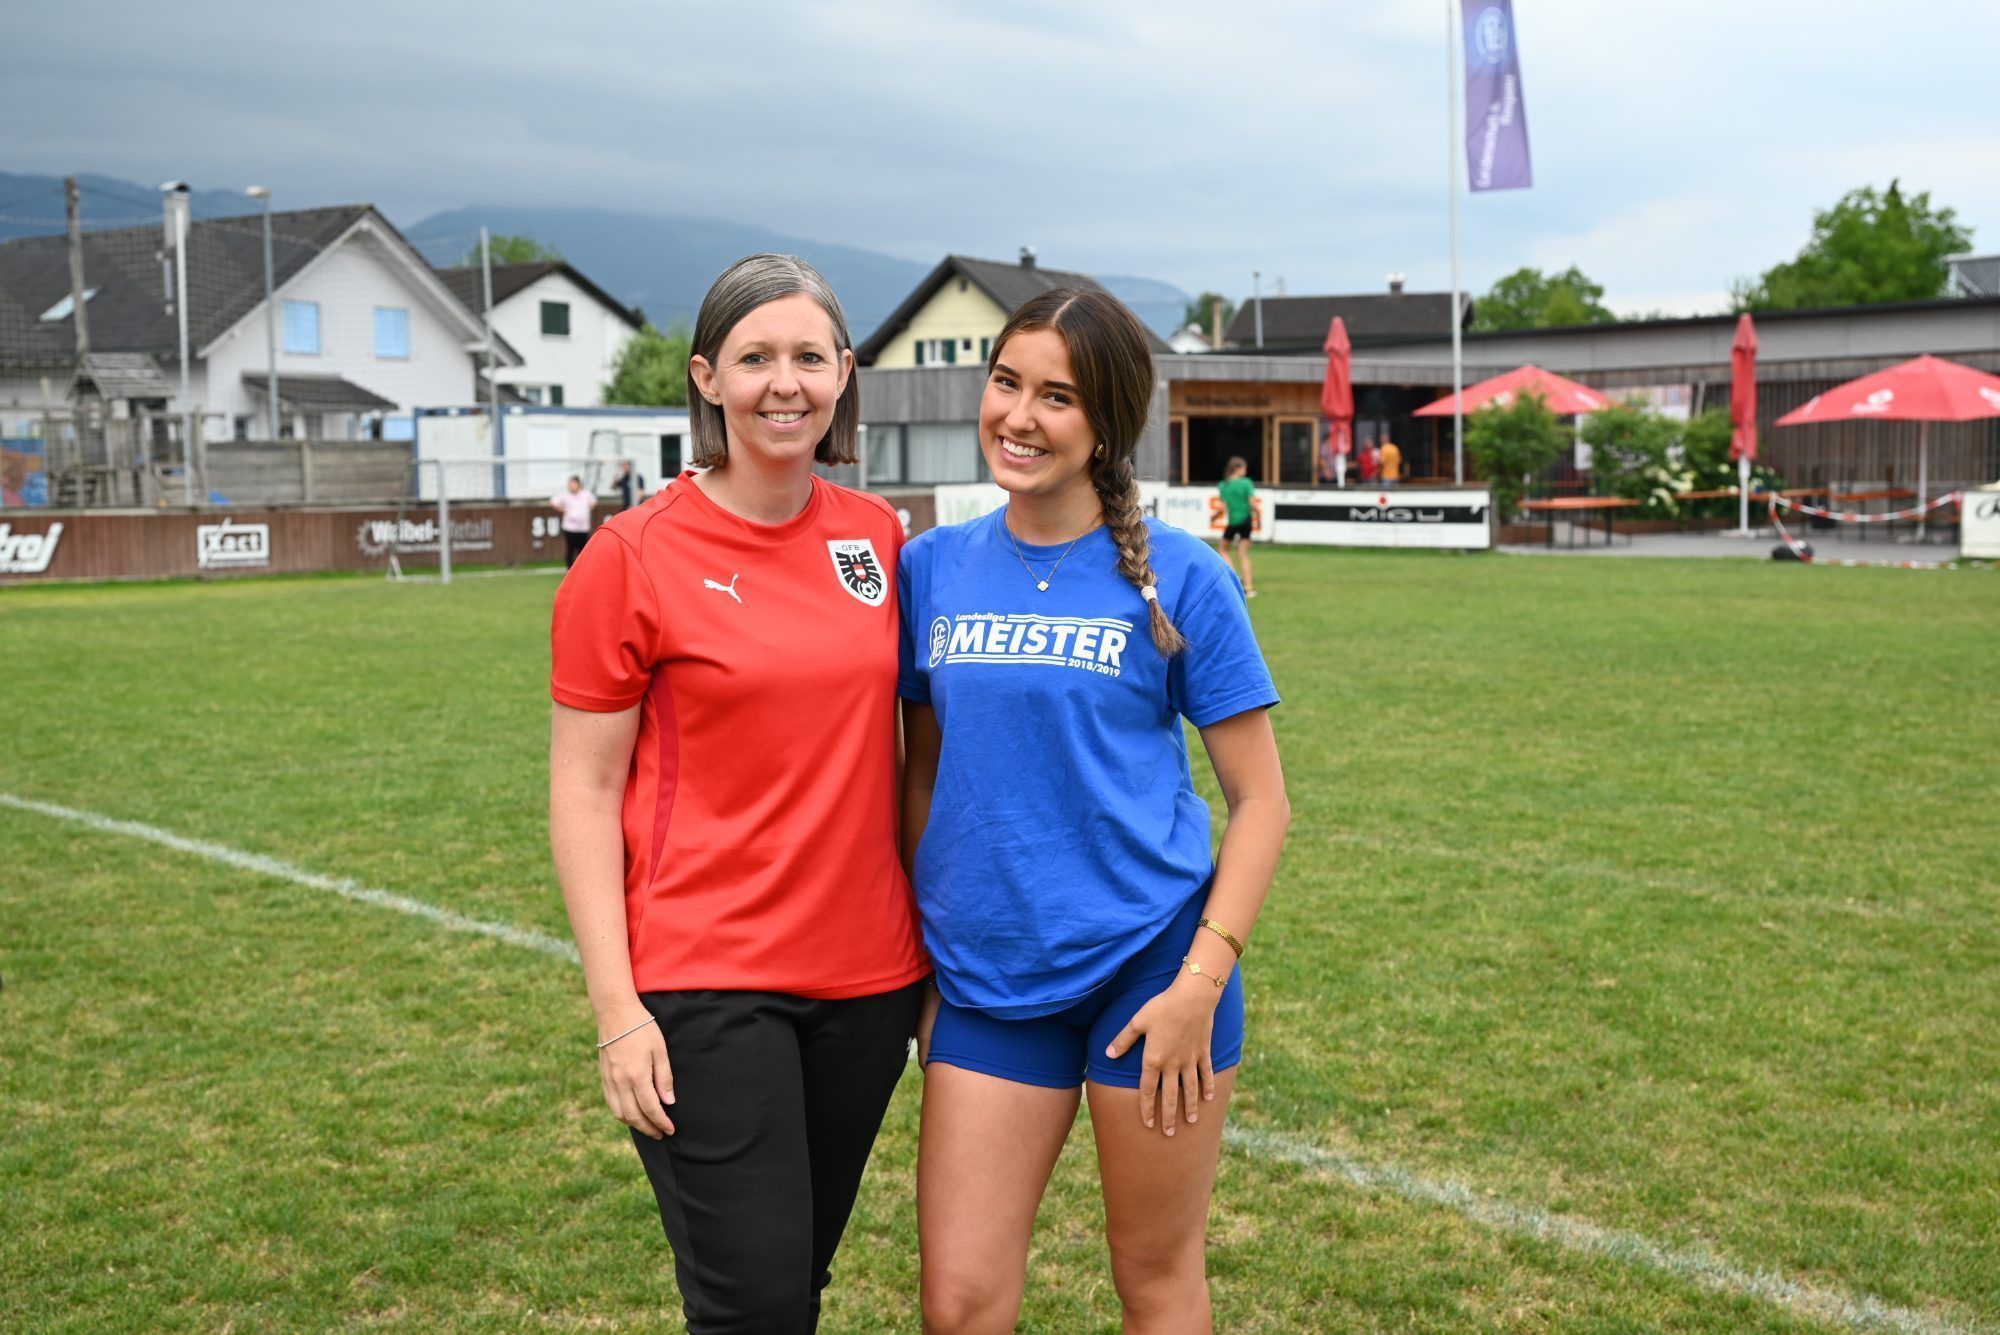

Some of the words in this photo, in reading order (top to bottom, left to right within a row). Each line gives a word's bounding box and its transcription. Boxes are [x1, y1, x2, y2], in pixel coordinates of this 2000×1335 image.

[955, 612, 1005, 622] Landesliga
[948, 621, 1127, 668] MEISTER
[1067, 658, 1120, 678] 2018/2019
